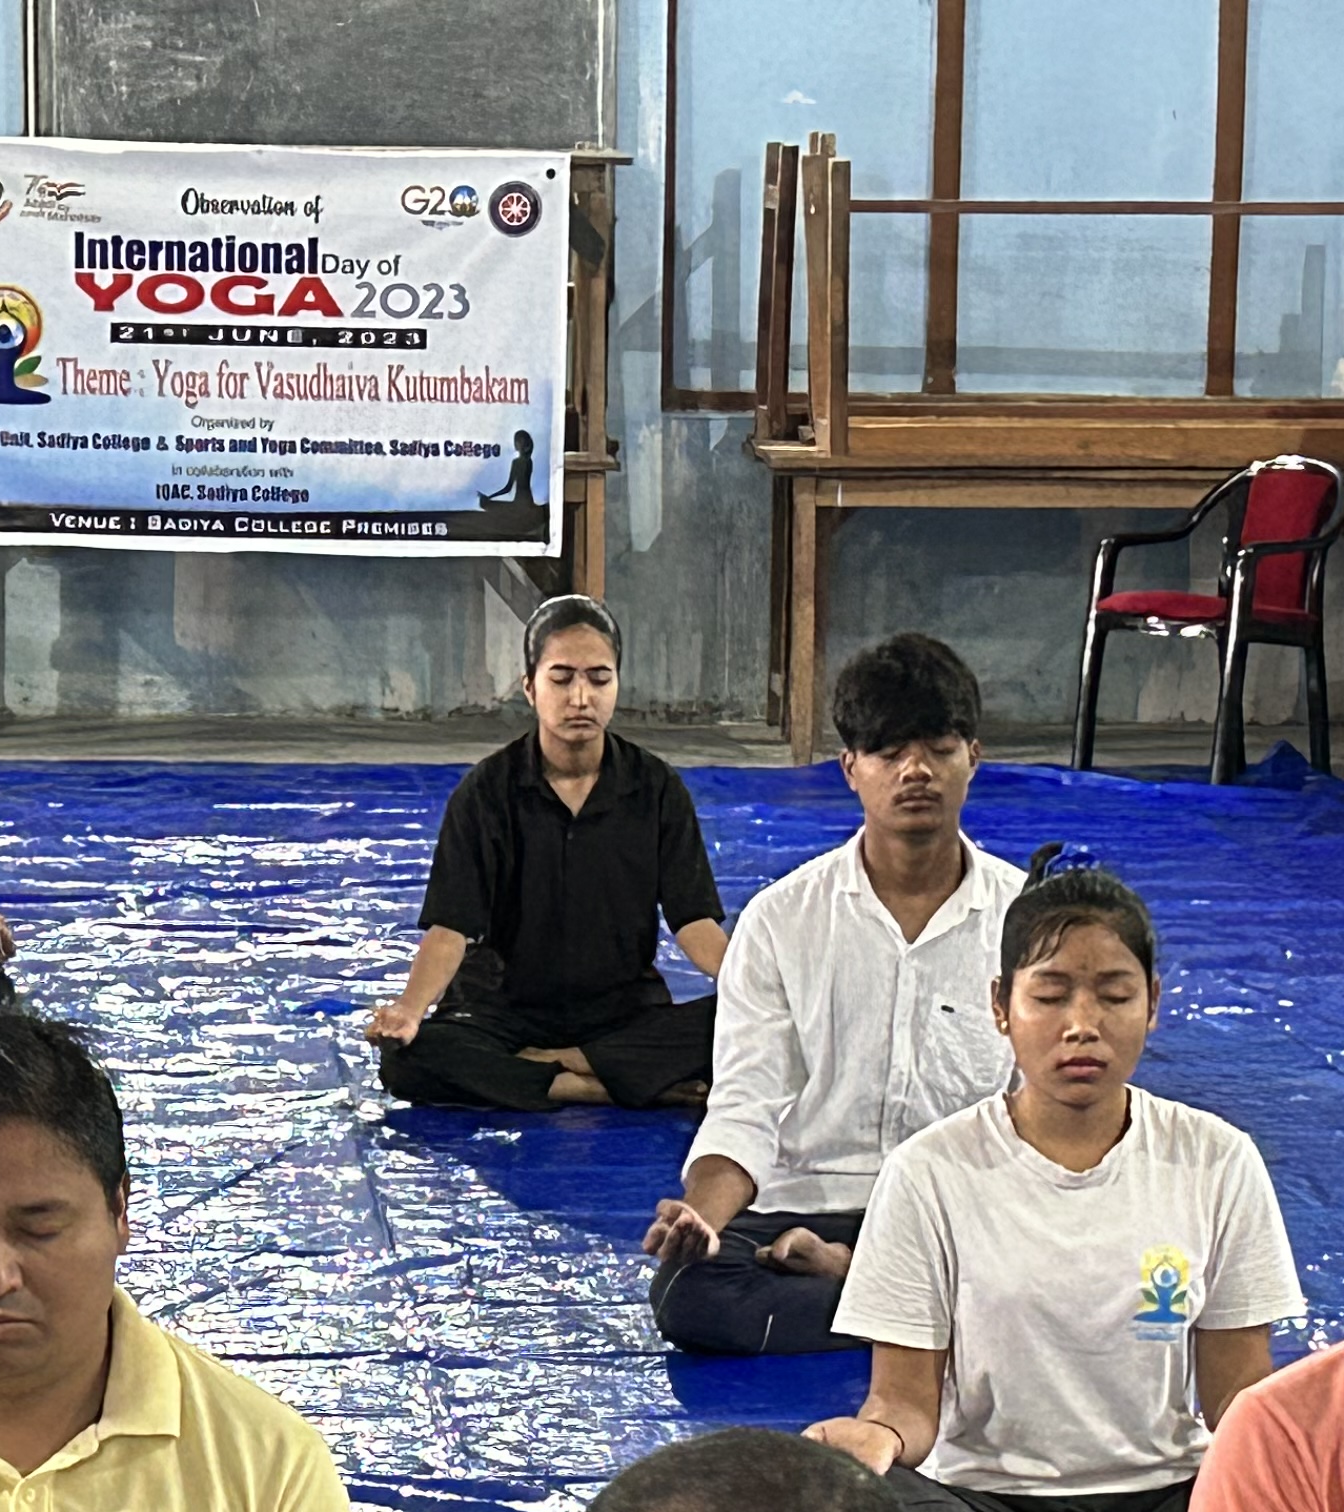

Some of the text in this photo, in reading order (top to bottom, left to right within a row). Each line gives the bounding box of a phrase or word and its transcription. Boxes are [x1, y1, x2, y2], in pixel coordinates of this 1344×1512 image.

[181, 187, 323, 224] Observation of
[74, 231, 402, 280] International Day of
[75, 272, 471, 320] YOGA 2023
[338, 330, 421, 346] 2023
[57, 357, 132, 396] Theme
[152, 359, 212, 407] Yoga
[217, 359, 250, 396] for
[254, 360, 381, 402] Vasudhaiva
[388, 364, 530, 405] Kutumbakam
[260, 417, 275, 432] by
[37, 431, 88, 451] Sadiya
[92, 432, 151, 451] College
[156, 435, 169, 451] &
[175, 434, 225, 454] Sports
[229, 437, 257, 453] and
[260, 437, 297, 456] Yoga
[389, 439, 440, 458] Sadiya
[444, 440, 501, 458] College
[49, 513, 122, 531] VENUE
